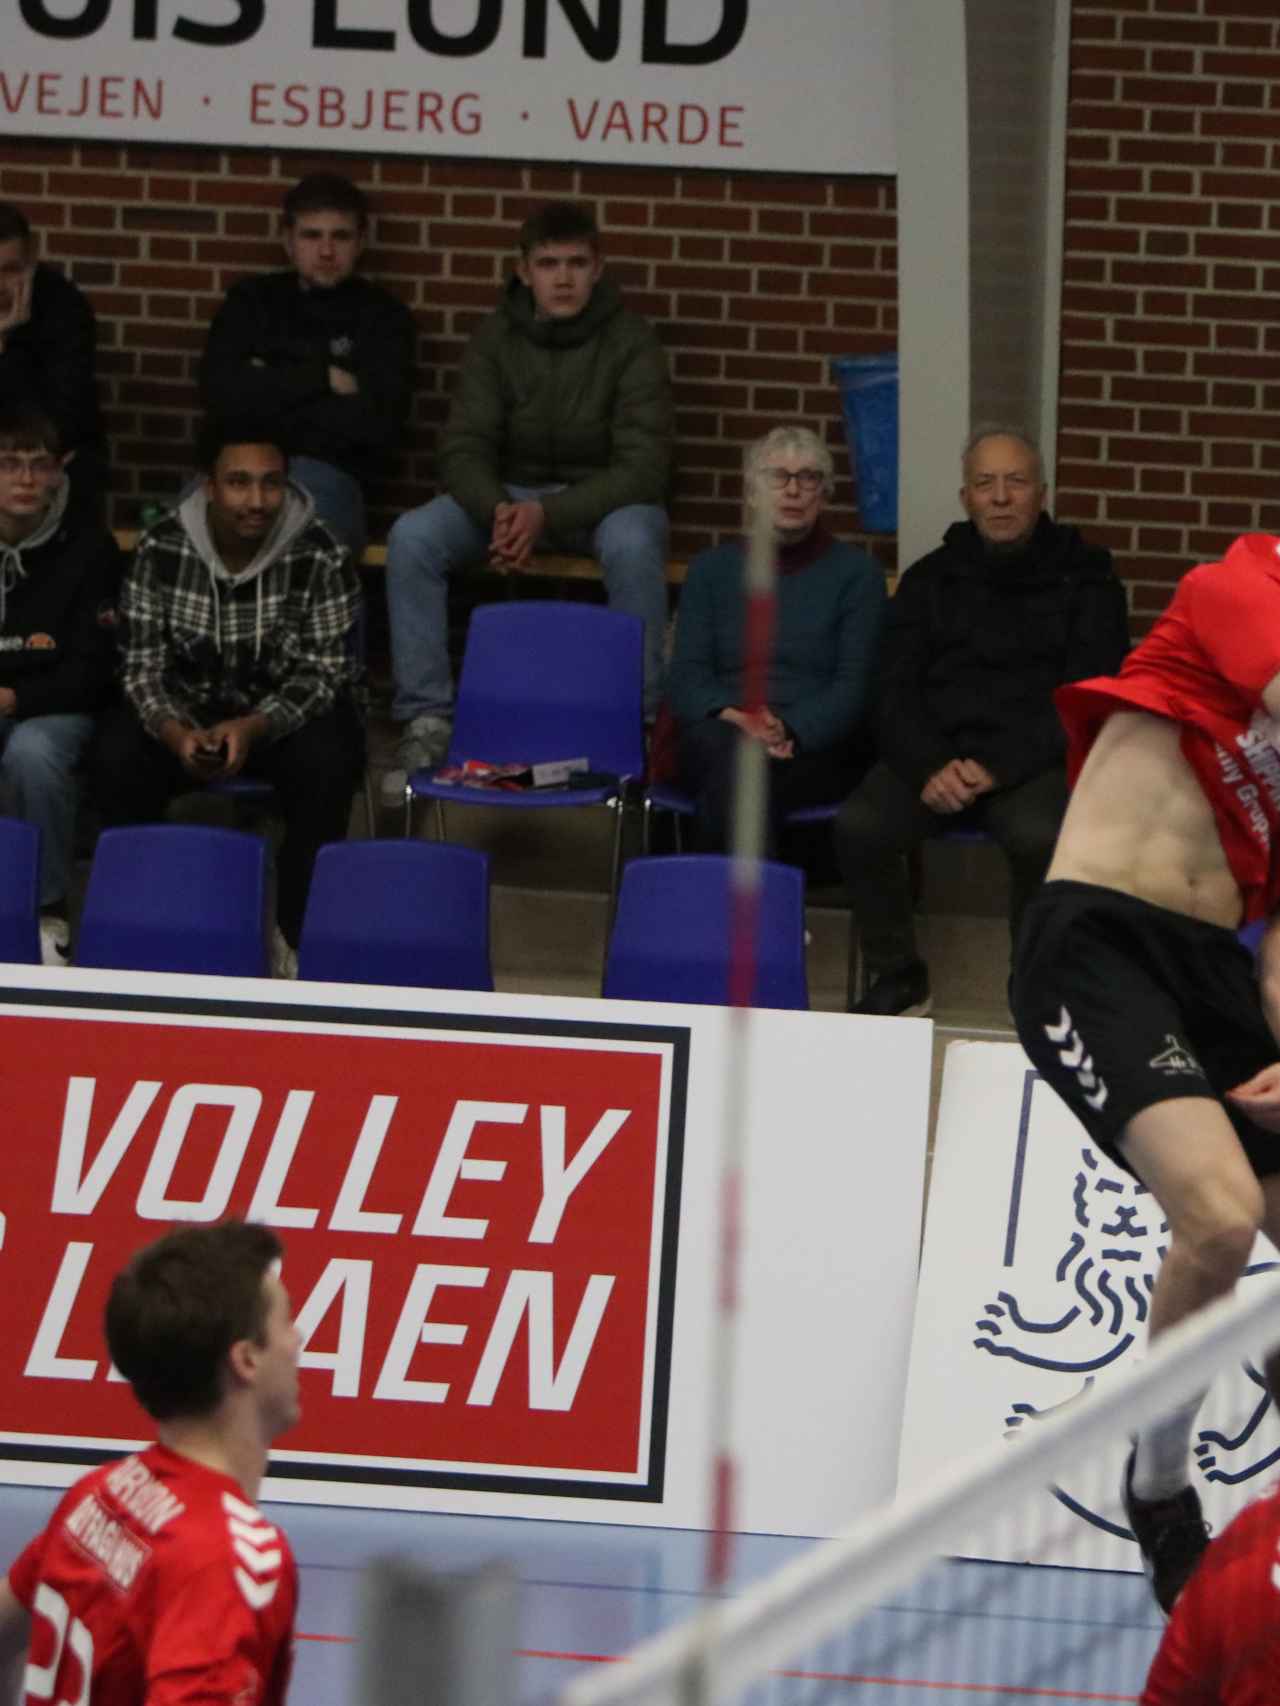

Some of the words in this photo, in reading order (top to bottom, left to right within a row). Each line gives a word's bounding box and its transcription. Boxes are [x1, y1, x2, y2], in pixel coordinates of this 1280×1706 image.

[0, 71, 164, 120] VEJEN
[251, 83, 482, 135] ESBJERG
[567, 98, 745, 147] VARDE
[51, 1076, 632, 1244] VOLLEY
[24, 1242, 616, 1412] LAEN
